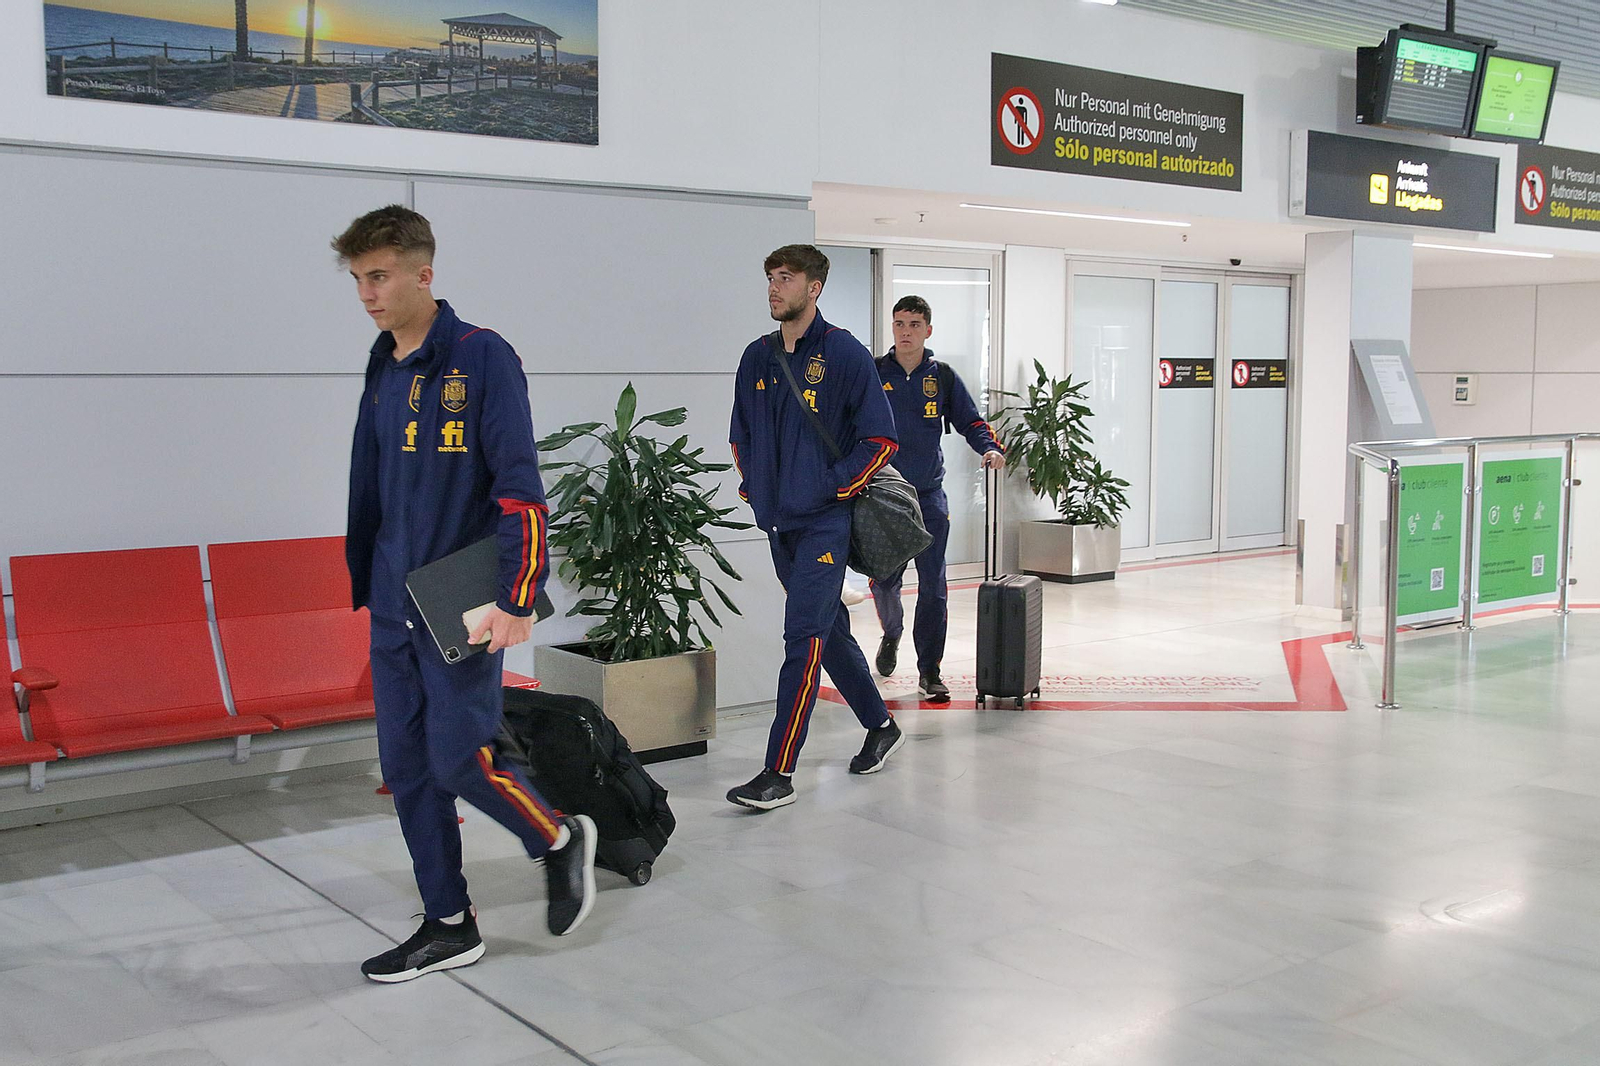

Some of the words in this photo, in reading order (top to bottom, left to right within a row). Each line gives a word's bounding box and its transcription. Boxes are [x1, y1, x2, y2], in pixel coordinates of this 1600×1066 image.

[137, 85, 146, 93] El
[147, 86, 165, 96] Toyo
[1055, 88, 1077, 109] Nur
[1080, 92, 1130, 117] Personal
[1132, 100, 1151, 120] mit
[1154, 103, 1227, 134] Genehmigung
[1054, 113, 1116, 138] Authorized
[1119, 125, 1173, 146] personnel
[1175, 131, 1198, 152] only
[1054, 136, 1089, 161] Sólo
[1093, 144, 1158, 169] personal
[1161, 154, 1235, 178] autorizado
[1551, 165, 1566, 180] Nur
[1566, 166, 1596, 184] Personal
[1395, 190, 1443, 212] Llegadas
[1550, 183, 1587, 201] Authorized
[1550, 200, 1570, 218] Sólo
[441, 421, 464, 445] fi
[1496, 474, 1511, 484] aena
